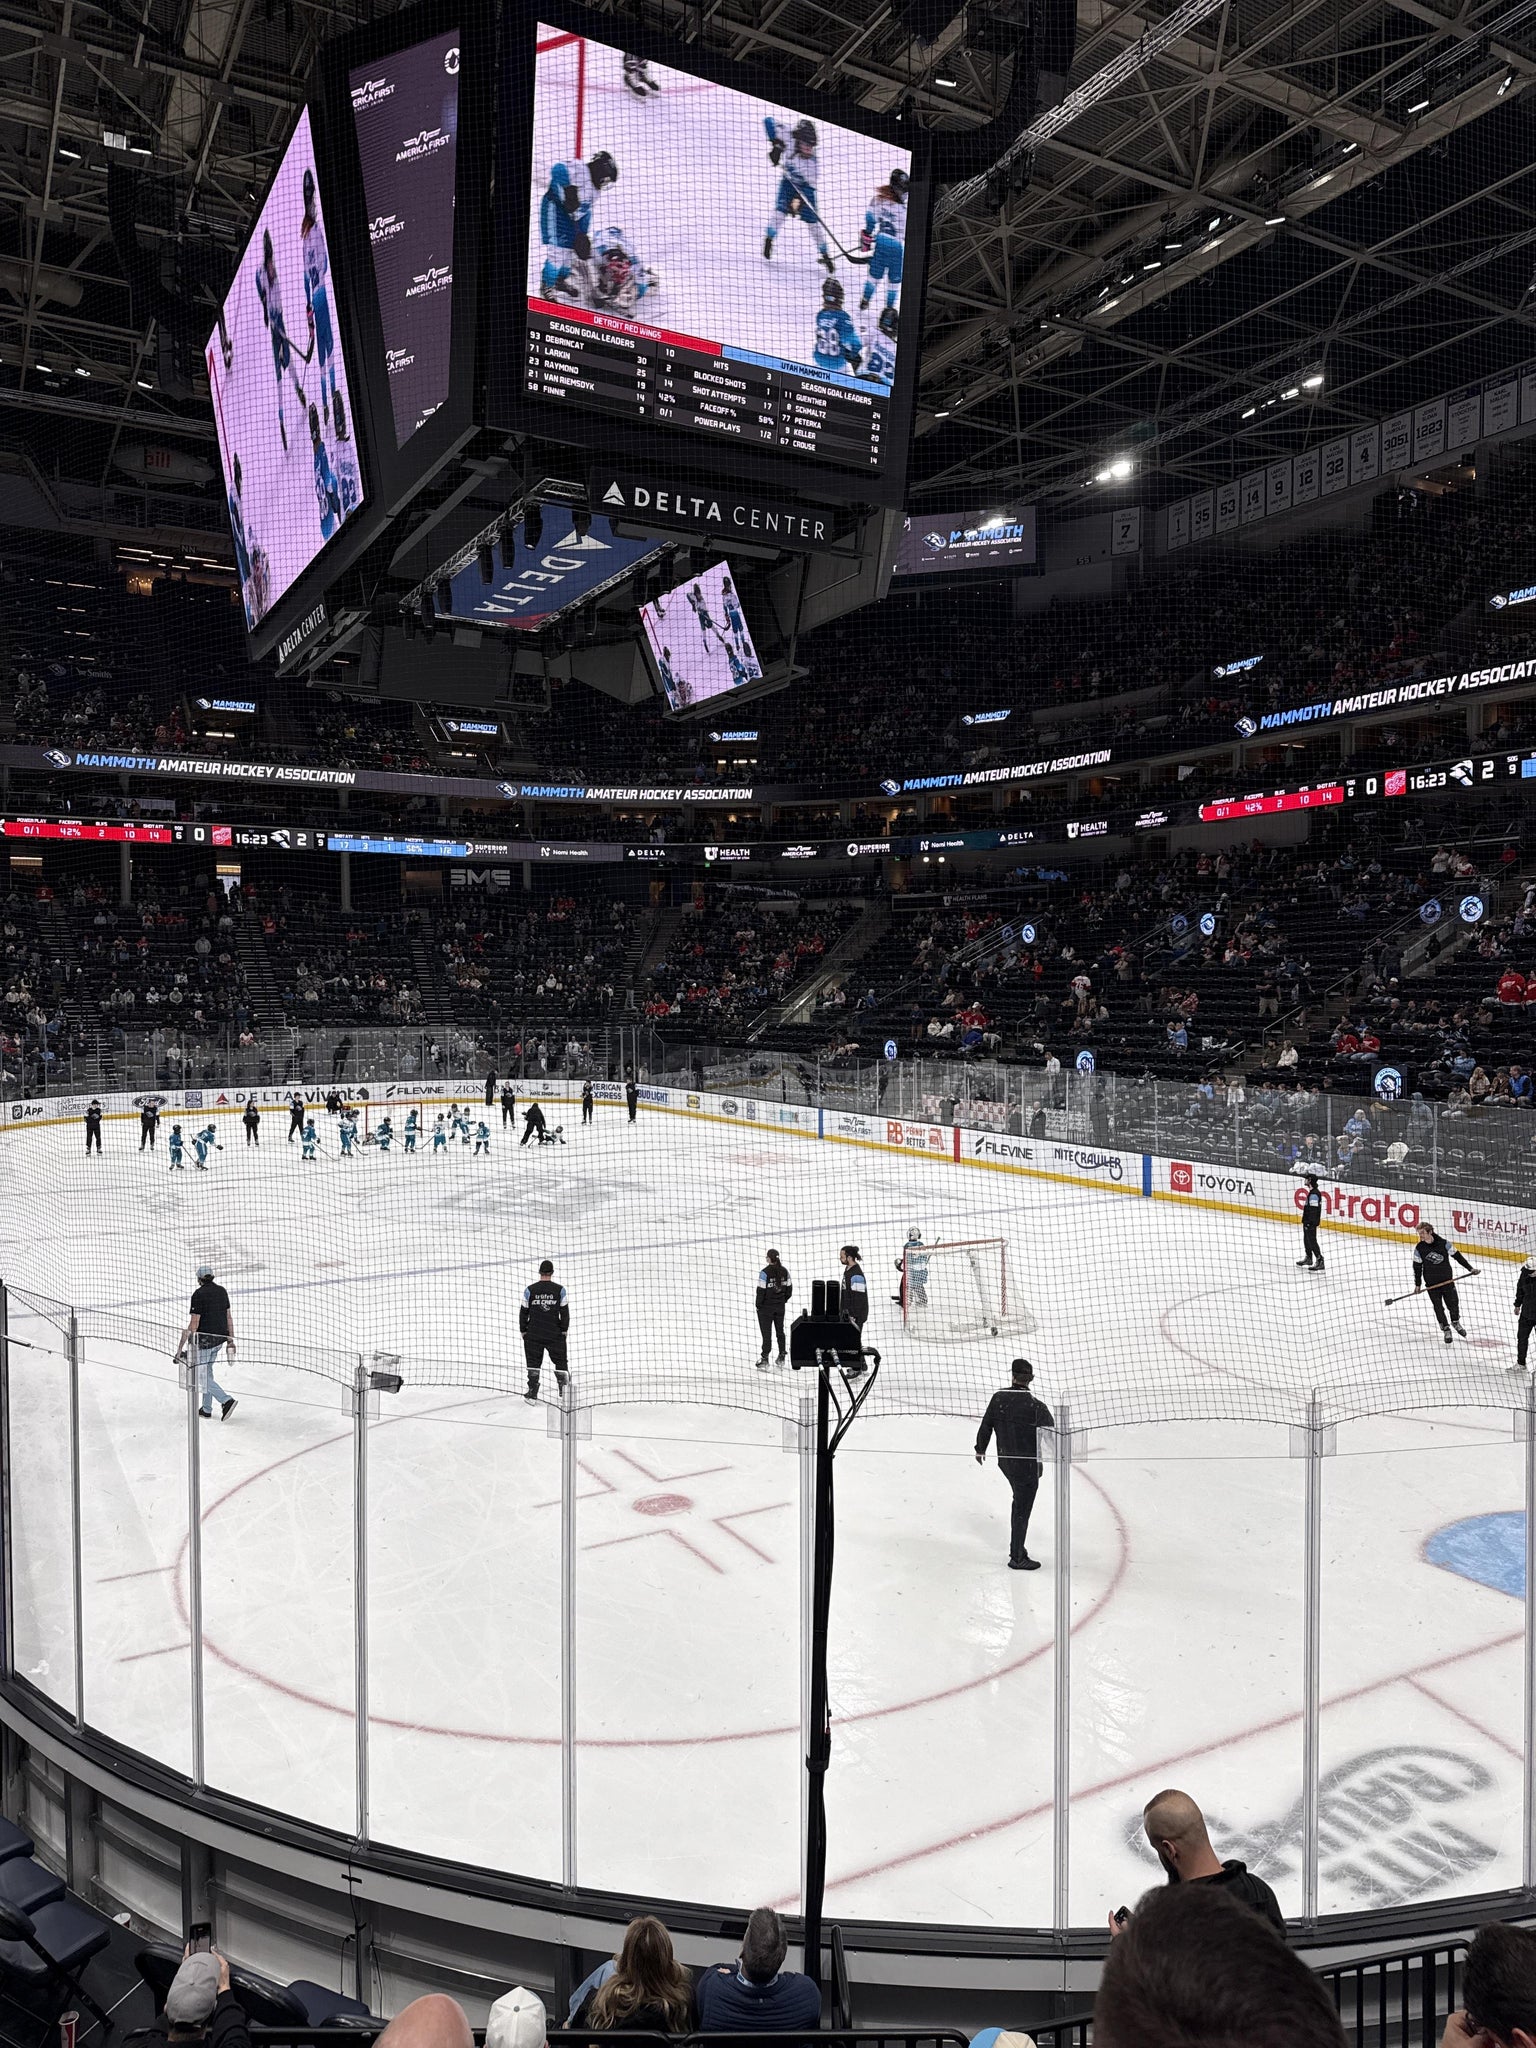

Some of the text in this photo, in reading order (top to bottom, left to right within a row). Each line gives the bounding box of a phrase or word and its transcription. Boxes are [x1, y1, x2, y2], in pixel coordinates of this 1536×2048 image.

[374, 84, 395, 100] FIRST
[395, 143, 428, 162] AMERICA
[428, 134, 450, 150] FIRST
[384, 221, 405, 236] FIRST
[405, 280, 437, 297] AMERICA
[550, 321, 635, 348] SEASON GOAL LEADERS
[594, 316, 662, 339] DETROIT RED WINGS
[530, 331, 647, 364] 93 DEBRINCAT 30
[395, 355, 415, 369] FIRST
[529, 344, 646, 377] 71 LARKIN 25
[666, 349, 675, 357] 10
[714, 361, 729, 370] HITS
[529, 357, 645, 389] 23 RAYMOND 19
[781, 362, 830, 380] UTAH MAMMOTH
[528, 369, 645, 401] 21 VAN RIEMSDYK 14
[694, 371, 723, 384] BLOCKED
[725, 378, 746, 389] SHOTS
[528, 382, 538, 391] 58
[543, 386, 566, 397] FINNIE
[664, 379, 772, 410] 14 SHOT ATTEMPTS 17
[801, 382, 872, 405] SEASON GOAL LEADERS
[785, 391, 792, 399] 11
[796, 394, 827, 407] GUENTHER
[659, 393, 774, 425] 42% FACEOFF % 58%
[660, 408, 771, 439] 0/1 POWER PLAYS 1/2
[795, 406, 826, 418] SCHMALTZ
[872, 423, 880, 431] 23
[782, 414, 879, 442] 77 PETERKA 20
[794, 429, 816, 439] KELLER
[1415, 419, 1443, 439] 1223
[793, 440, 816, 451] CROUSE
[1383, 433, 1409, 451] 3051
[1360, 448, 1369, 463] 4
[1326, 458, 1344, 477] 32
[1299, 469, 1314, 487] 12
[1274, 480, 1283, 496] 9
[634, 487, 825, 540] DELTA CENTER
[1220, 500, 1236, 515] 53
[1195, 508, 1210, 525] 35
[1121, 524, 1131, 538] 7
[473, 555, 587, 613] DELTA
[282, 603, 326, 657] DELTA CENTER
[213, 699, 255, 709] MAMMOTH
[1260, 676, 1457, 730] MAMMOTH AMATEUR HOCKEY
[76, 754, 356, 784] MAMMOTH AMATEUR HOCKEY ASSOCIATION
[903, 749, 1111, 791] MAMMOTH AMATEUR HOCKEY ASSOCIATION
[1482, 760, 1494, 779] 2
[1508, 763, 1516, 774] 9
[1365, 778, 1377, 795] 0
[1409, 772, 1446, 790] 16:23
[521, 786, 753, 800] MAMMOTH AMATEUR HOCKEY ASSOCIATION
[1347, 787, 1354, 797] 6
[1216, 792, 1332, 817] 0/1 42% 2 10 14
[1080, 821, 1108, 832] HEALTH
[1134, 819, 1154, 827] AMERICA
[24, 826, 159, 840] 0/1 42% 2 10 14
[175, 832, 182, 840] 6
[194, 827, 205, 841] 0
[235, 833, 268, 845] 16:23
[296, 833, 307, 846] 2
[1007, 831, 1034, 841] DELTA
[317, 838, 324, 846] 9
[859, 843, 890, 851] SUPERIOR
[720, 849, 750, 857] HEALTH
[451, 868, 510, 886] SME
[236, 1091, 293, 1103] DELTA
[397, 1086, 445, 1095] FILEVINE
[650, 1087, 669, 1102] LIGHT
[838, 1124, 858, 1133] AMERICA
[858, 1127, 871, 1136] FIRST
[887, 1120, 904, 1144] PB
[906, 1126, 926, 1136] PEANUT
[906, 1137, 926, 1149] BETTER
[985, 1141, 1033, 1160] FILEVINE
[1197, 1173, 1256, 1196] TOYOTA
[1293, 1187, 1420, 1229] entrata
[1477, 1217, 1528, 1236] HEALTH
